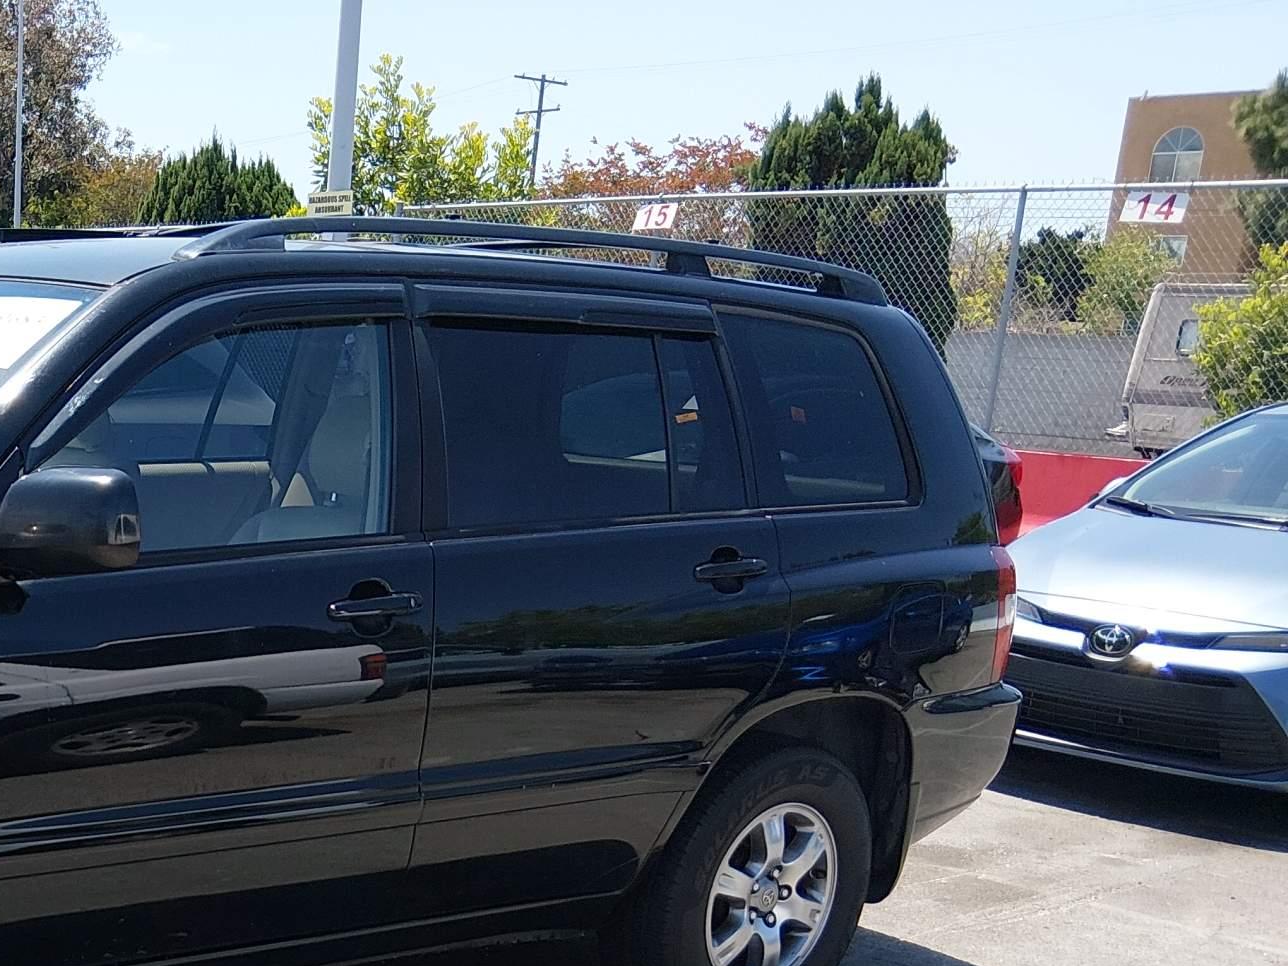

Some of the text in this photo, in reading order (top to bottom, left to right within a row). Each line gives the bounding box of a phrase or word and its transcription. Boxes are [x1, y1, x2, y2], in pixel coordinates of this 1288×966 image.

[309, 196, 337, 204] HAZARDOUS
[1138, 194, 1177, 220] 14
[644, 205, 670, 227] 15
